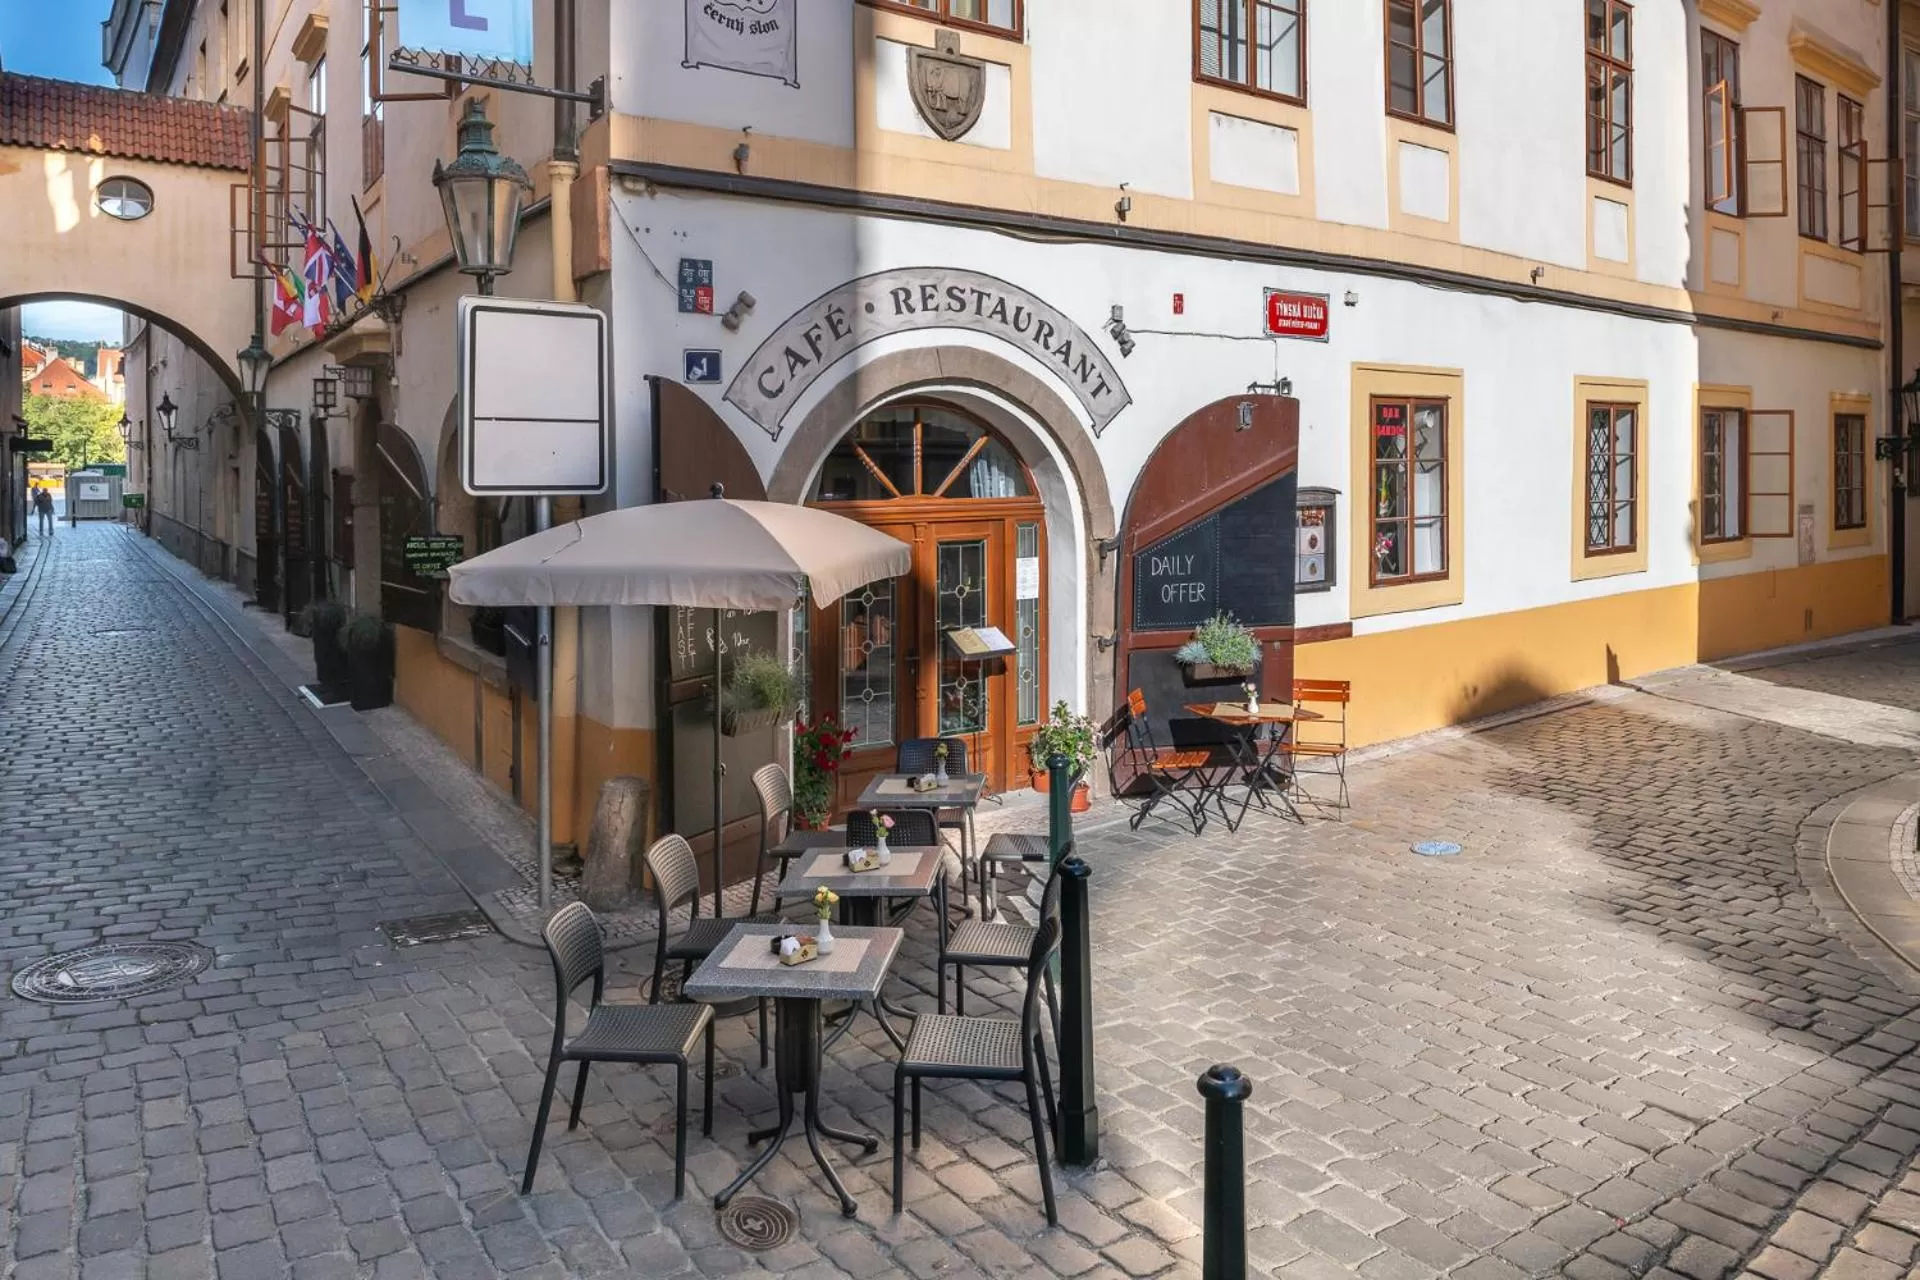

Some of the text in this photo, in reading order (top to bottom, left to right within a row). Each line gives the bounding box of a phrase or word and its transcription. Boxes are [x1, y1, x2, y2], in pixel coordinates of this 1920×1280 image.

[749, 19, 779, 34] slon
[758, 284, 1112, 399] CAFÉ RESTAURANT
[1151, 554, 1195, 576] DAILY
[1161, 582, 1206, 603] OFFER
